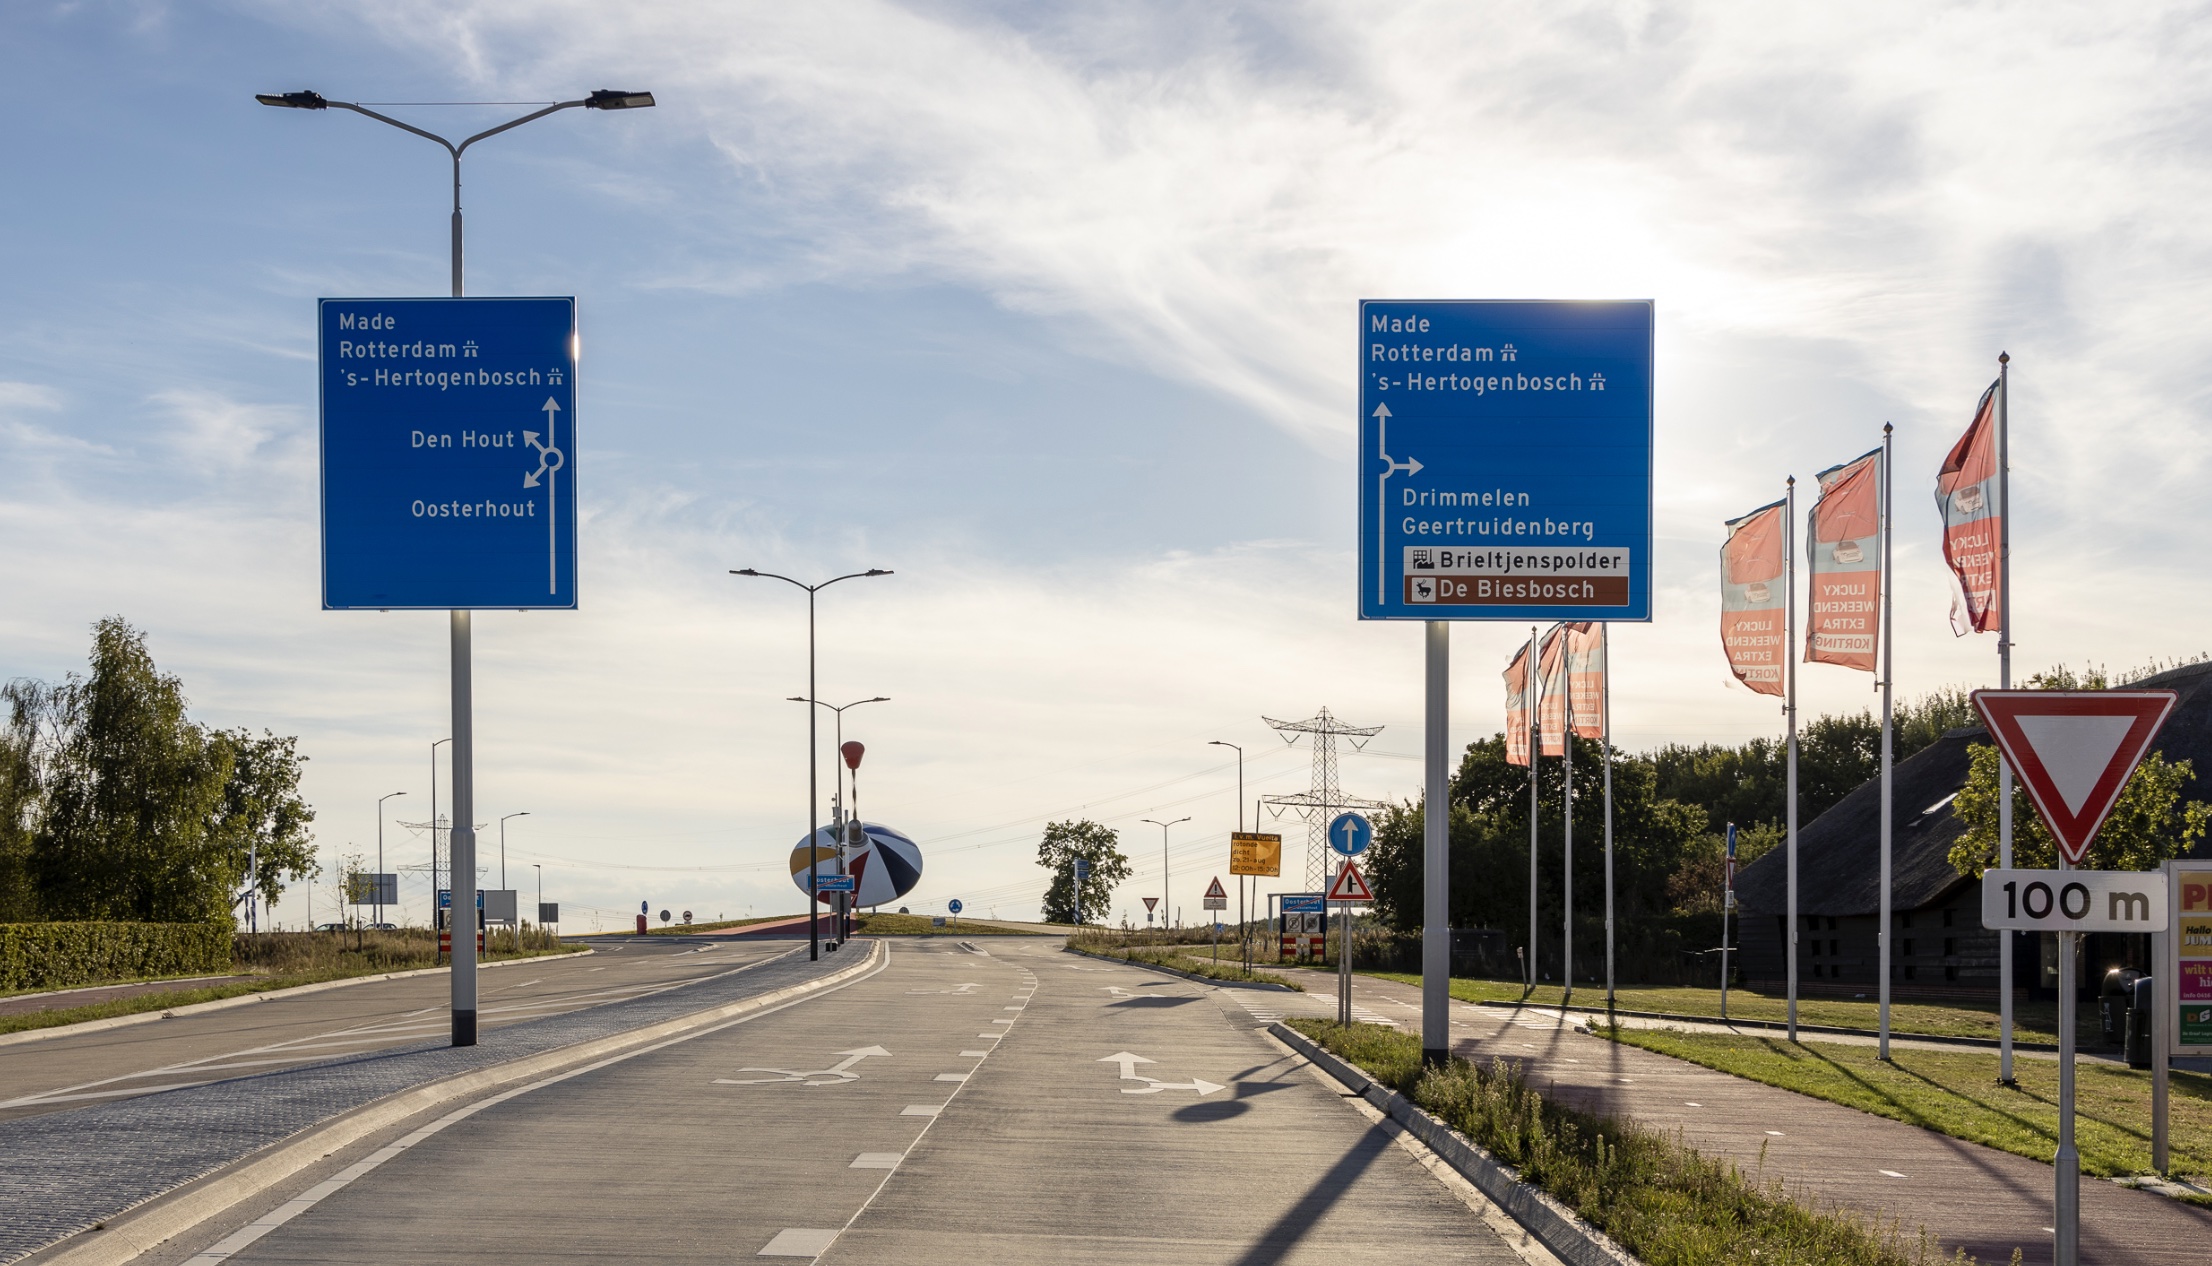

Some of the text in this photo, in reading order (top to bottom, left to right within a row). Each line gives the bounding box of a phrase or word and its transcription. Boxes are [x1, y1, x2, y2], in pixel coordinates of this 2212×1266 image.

[339, 312, 396, 330] Made
[1371, 314, 1431, 333] Made
[339, 340, 456, 358] Rotterdam
[1371, 343, 1494, 362] Rotterdam
[411, 430, 514, 448] Den Hout
[1402, 487, 1530, 507] Drimmelen
[411, 499, 535, 517] Oosterhout
[1402, 517, 1594, 541] Geertruidenberg
[1440, 551, 1622, 574] Brieltjenspolder
[1439, 579, 1595, 599] De Biesbosch
[2003, 881, 2150, 921] 100 m
[2186, 926, 2211, 934] Hallo
[2184, 964, 2206, 975] wilt
